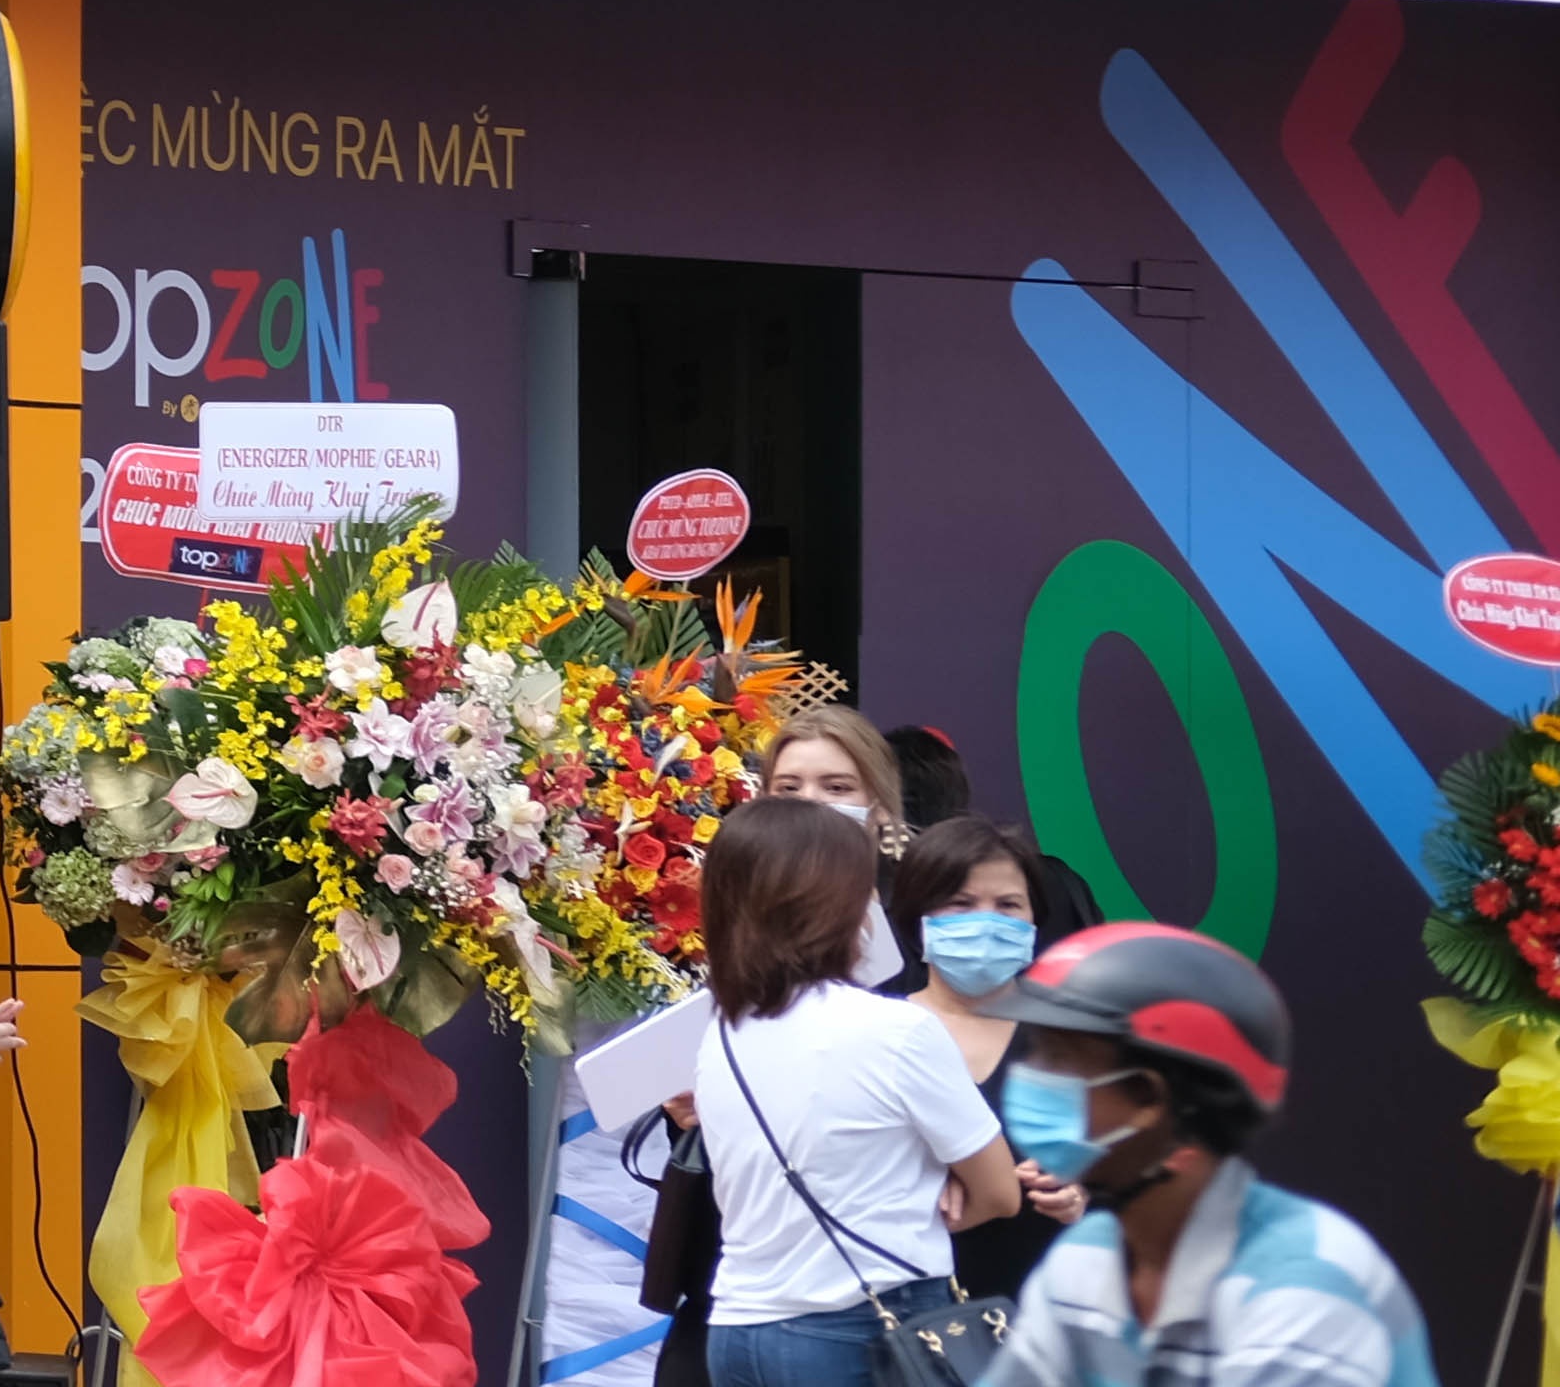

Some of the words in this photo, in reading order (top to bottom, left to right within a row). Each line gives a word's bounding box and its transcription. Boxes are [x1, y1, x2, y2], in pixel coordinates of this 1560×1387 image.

[152, 89, 320, 177] MỪNG
[335, 115, 404, 183] RA
[418, 104, 526, 190] MẮT
[161, 401, 179, 418] By
